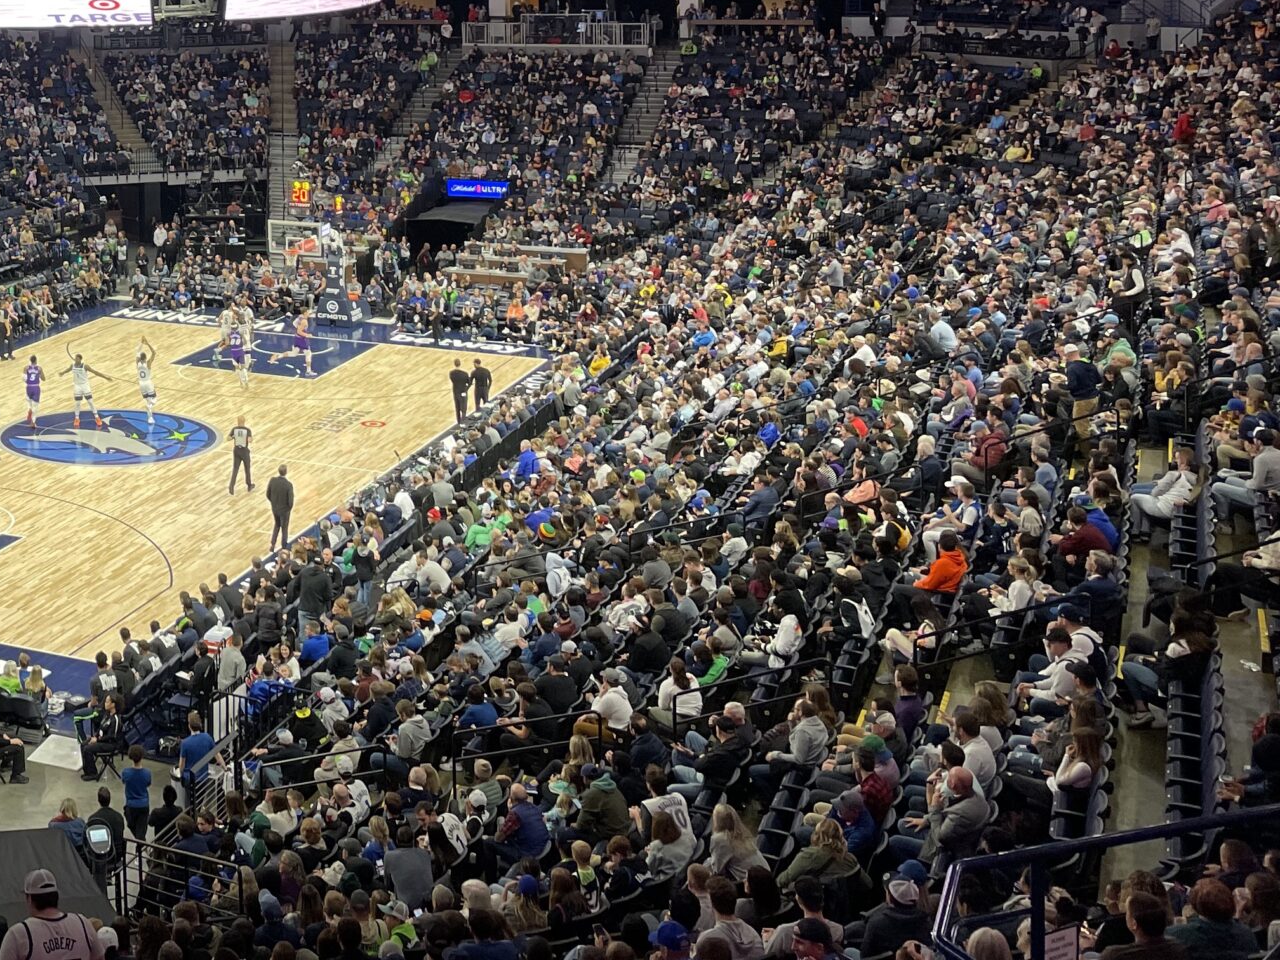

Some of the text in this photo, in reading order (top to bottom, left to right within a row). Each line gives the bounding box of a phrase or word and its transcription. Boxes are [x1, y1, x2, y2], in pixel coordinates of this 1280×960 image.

[292, 188, 308, 202] 20
[317, 312, 348, 321] CFMOTO
[30, 373, 37, 382] 5
[42, 936, 77, 954] GOBERT
